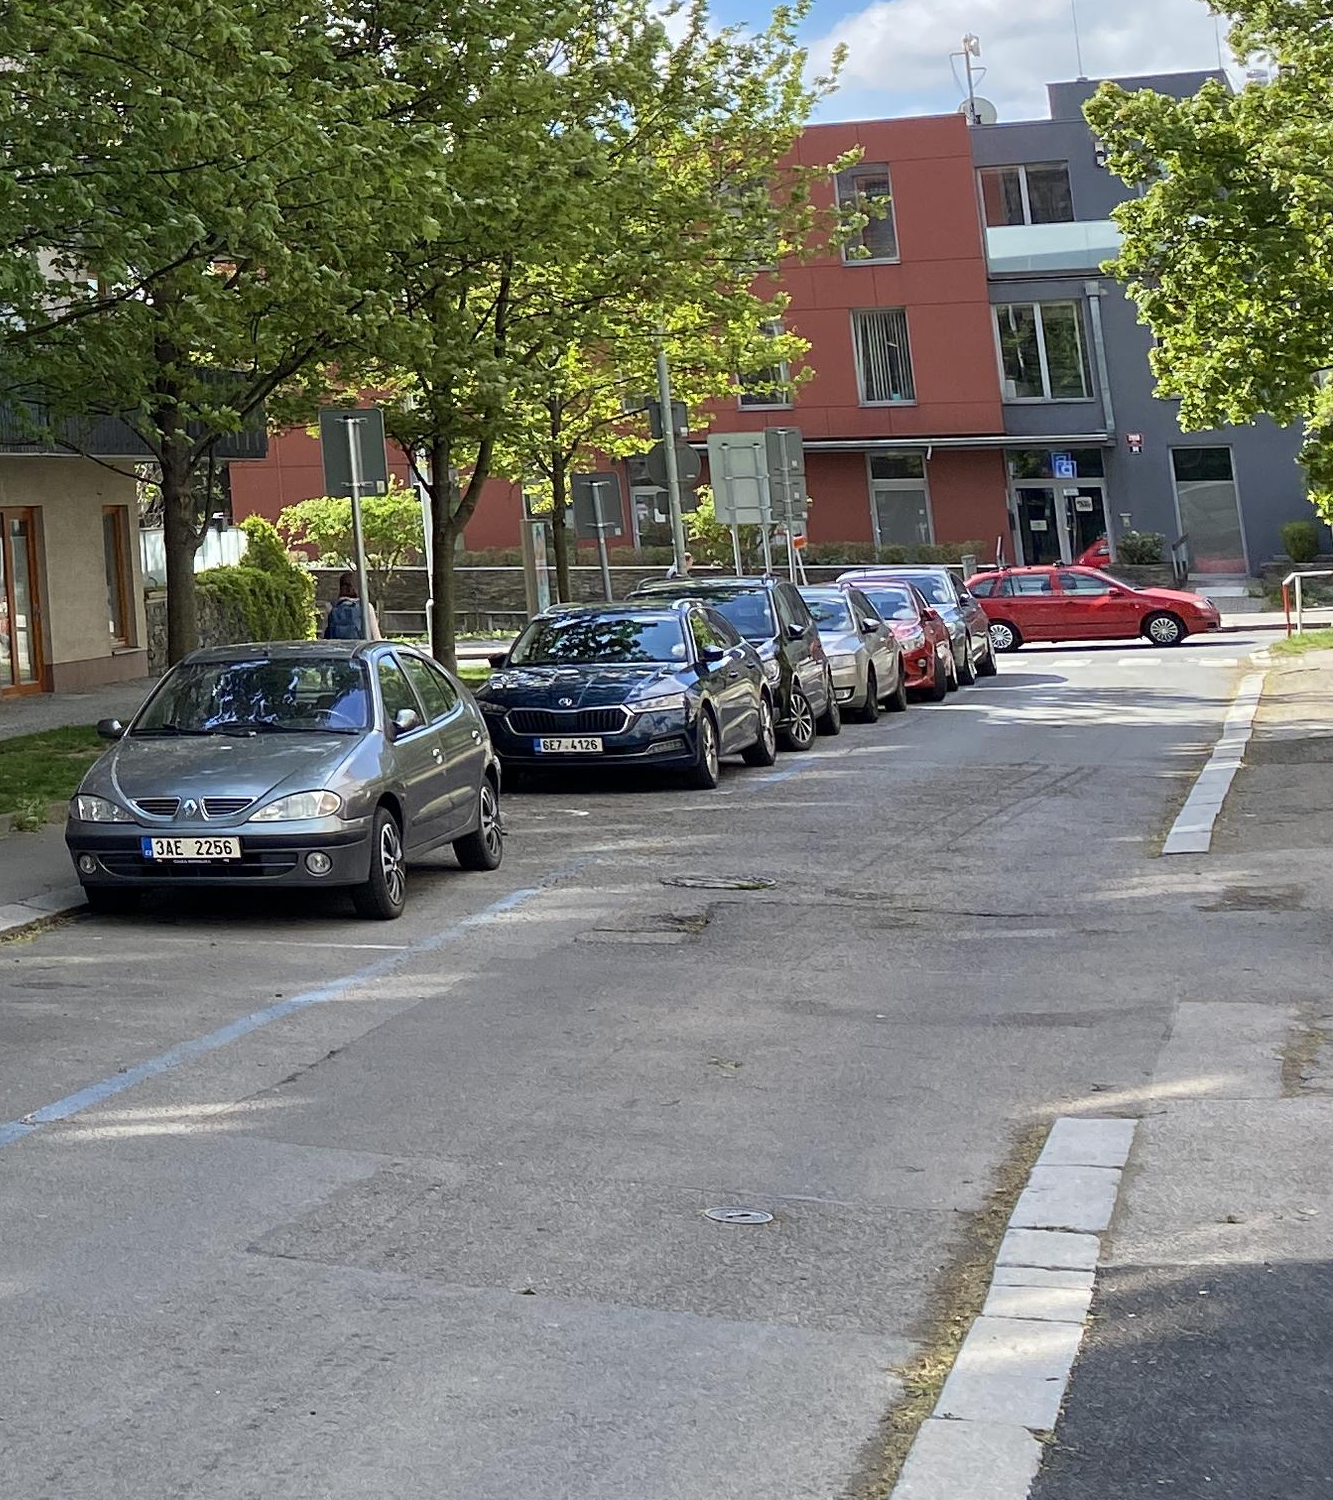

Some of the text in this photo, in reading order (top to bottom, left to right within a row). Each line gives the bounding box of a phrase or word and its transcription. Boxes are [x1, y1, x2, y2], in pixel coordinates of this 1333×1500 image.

[542, 739, 598, 750] 6E7 4126
[155, 840, 233, 856] 3AE 2256
